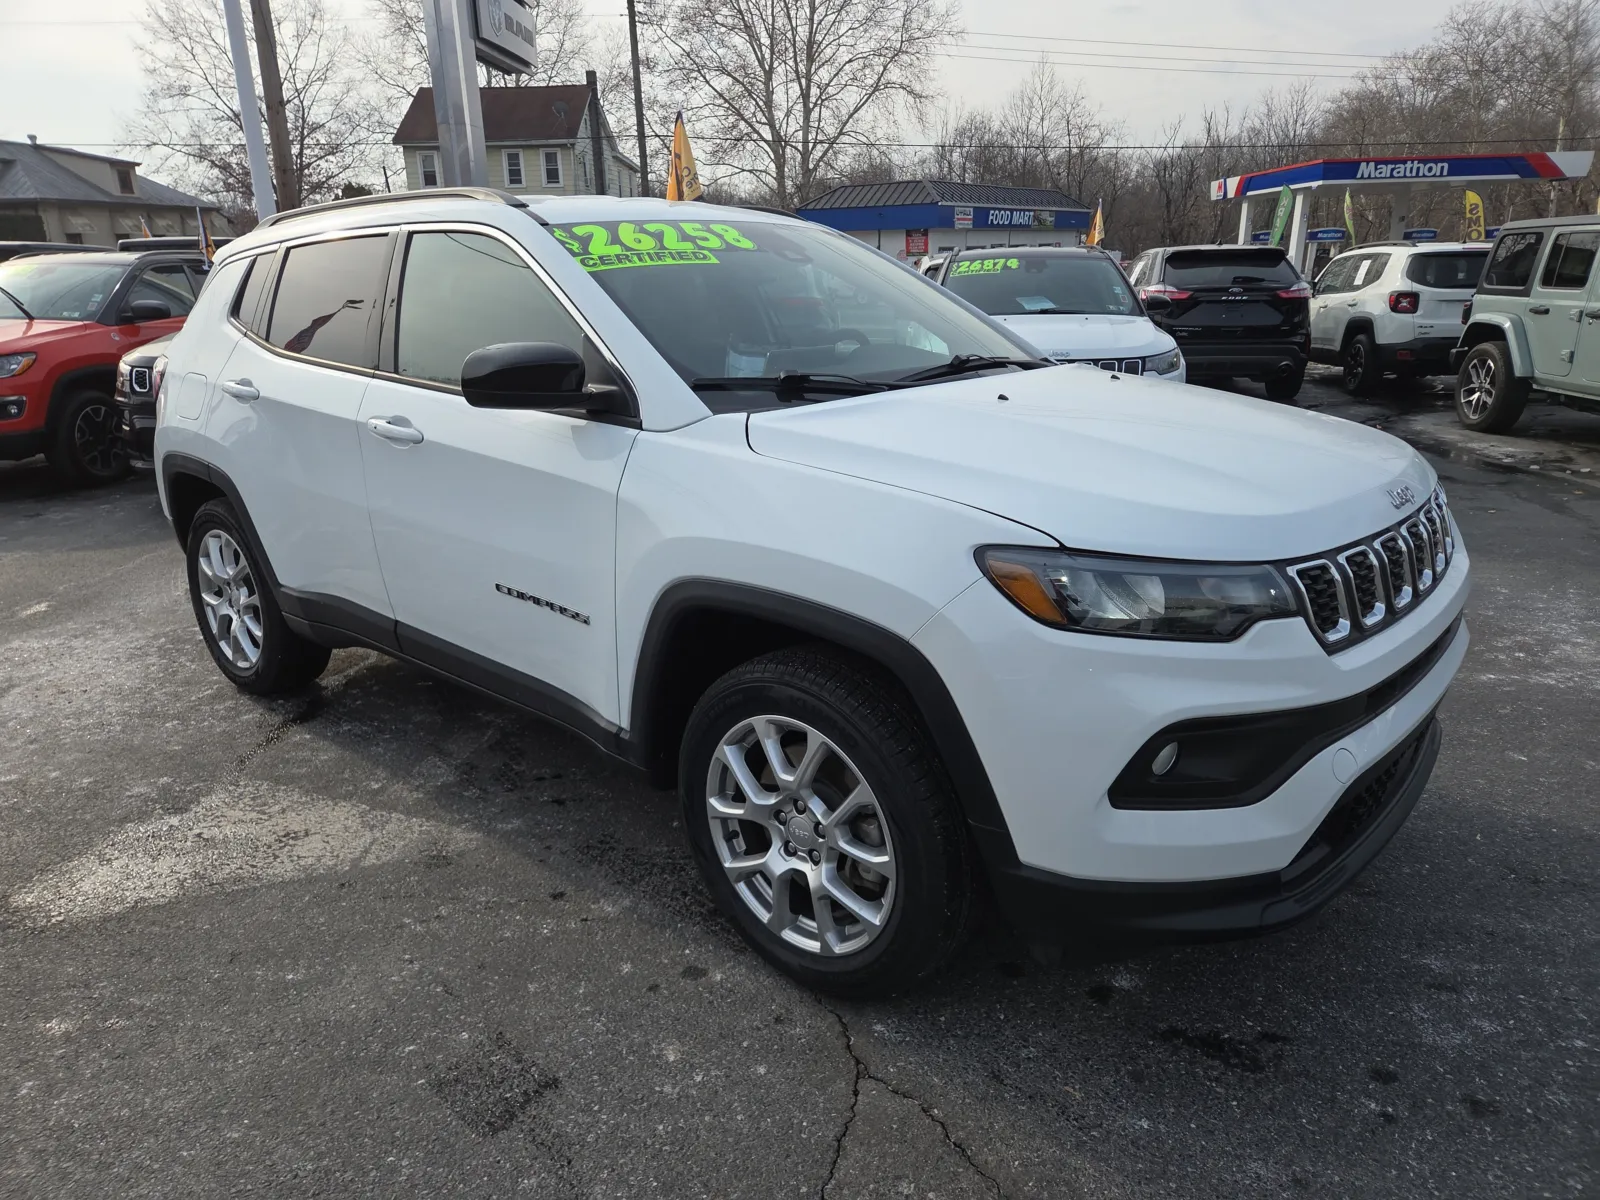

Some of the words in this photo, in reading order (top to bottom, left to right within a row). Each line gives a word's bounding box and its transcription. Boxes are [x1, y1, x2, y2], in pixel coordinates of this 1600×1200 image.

[504, 12, 535, 48] RAM
[1356, 160, 1449, 179] Marathon
[988, 210, 1011, 225] FOOD
[1011, 211, 1034, 226] MART
[552, 222, 757, 255] $26258
[579, 250, 712, 268] CERTIFIED
[951, 258, 1020, 272] $26874
[1049, 350, 1071, 358] Jeep
[1386, 485, 1416, 510] Jeep
[495, 582, 591, 626] COMPASS
[789, 825, 810, 839] Jeep
